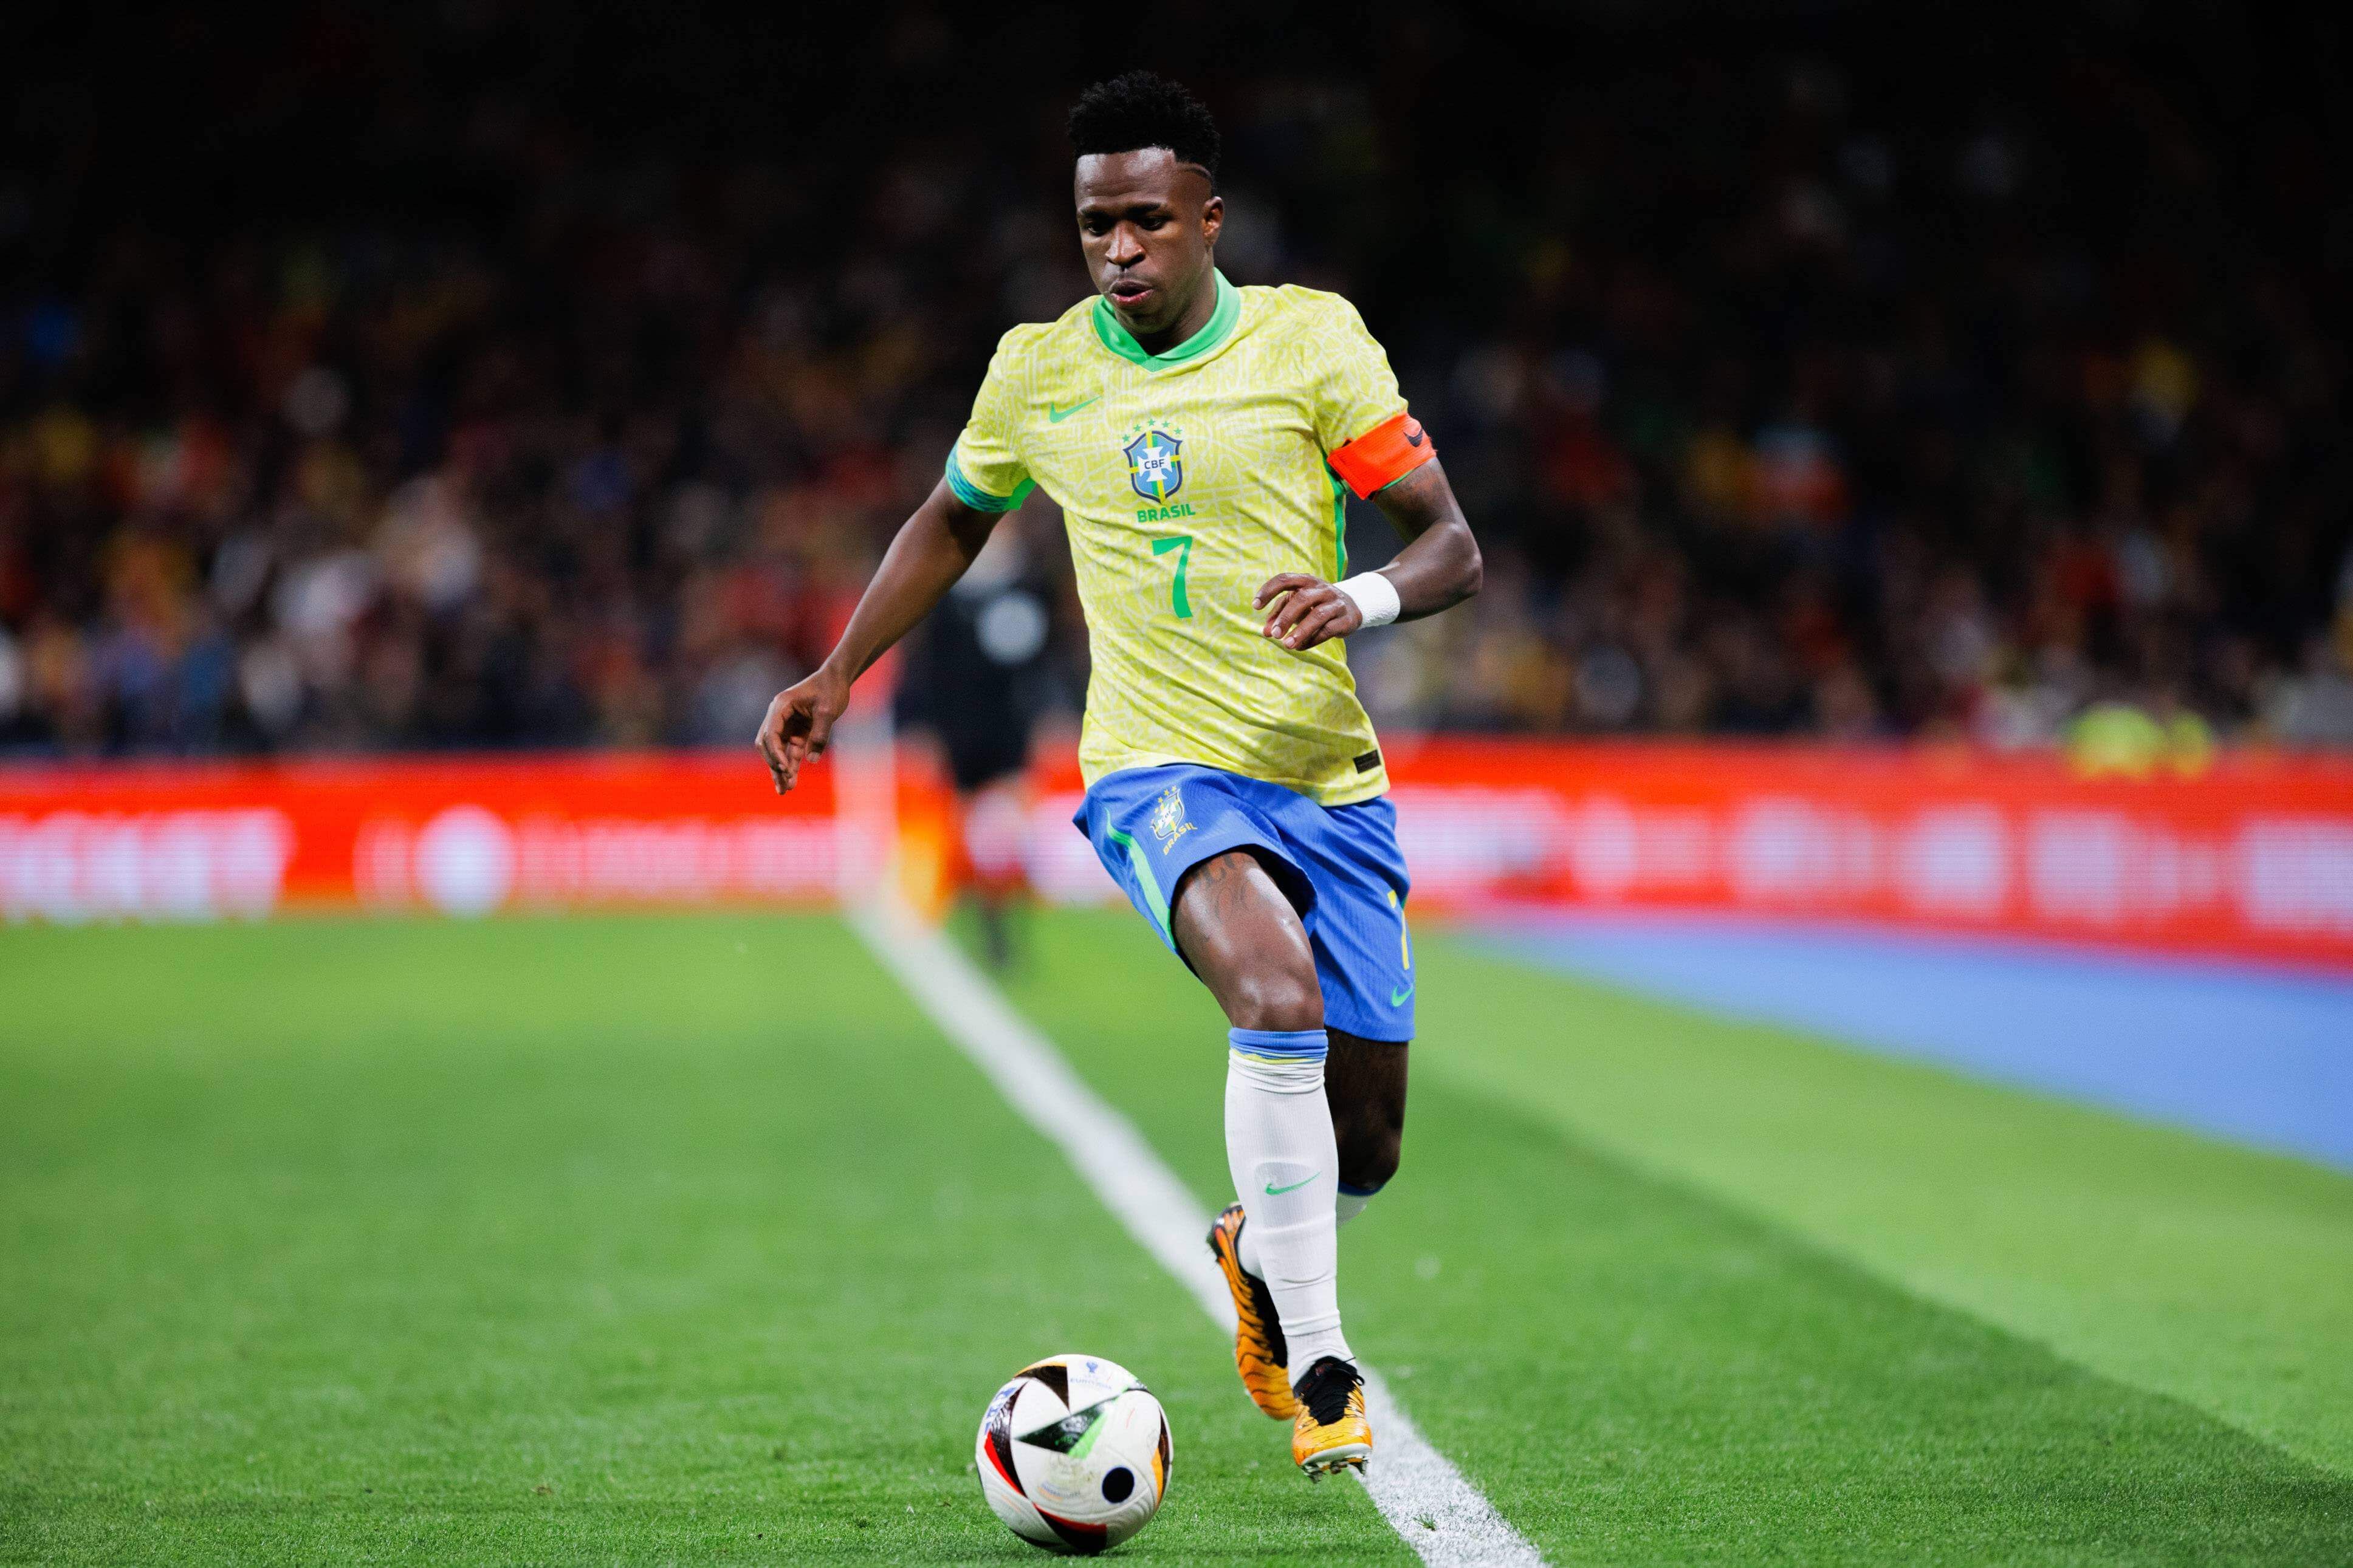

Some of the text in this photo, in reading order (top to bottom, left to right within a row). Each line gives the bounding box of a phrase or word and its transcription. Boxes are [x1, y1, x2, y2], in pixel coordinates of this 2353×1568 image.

[1144, 459, 1165, 470] CBF
[1137, 504, 1196, 523] BRASIL
[1152, 536, 1192, 618] 7
[1163, 822, 1198, 855] BRASIL
